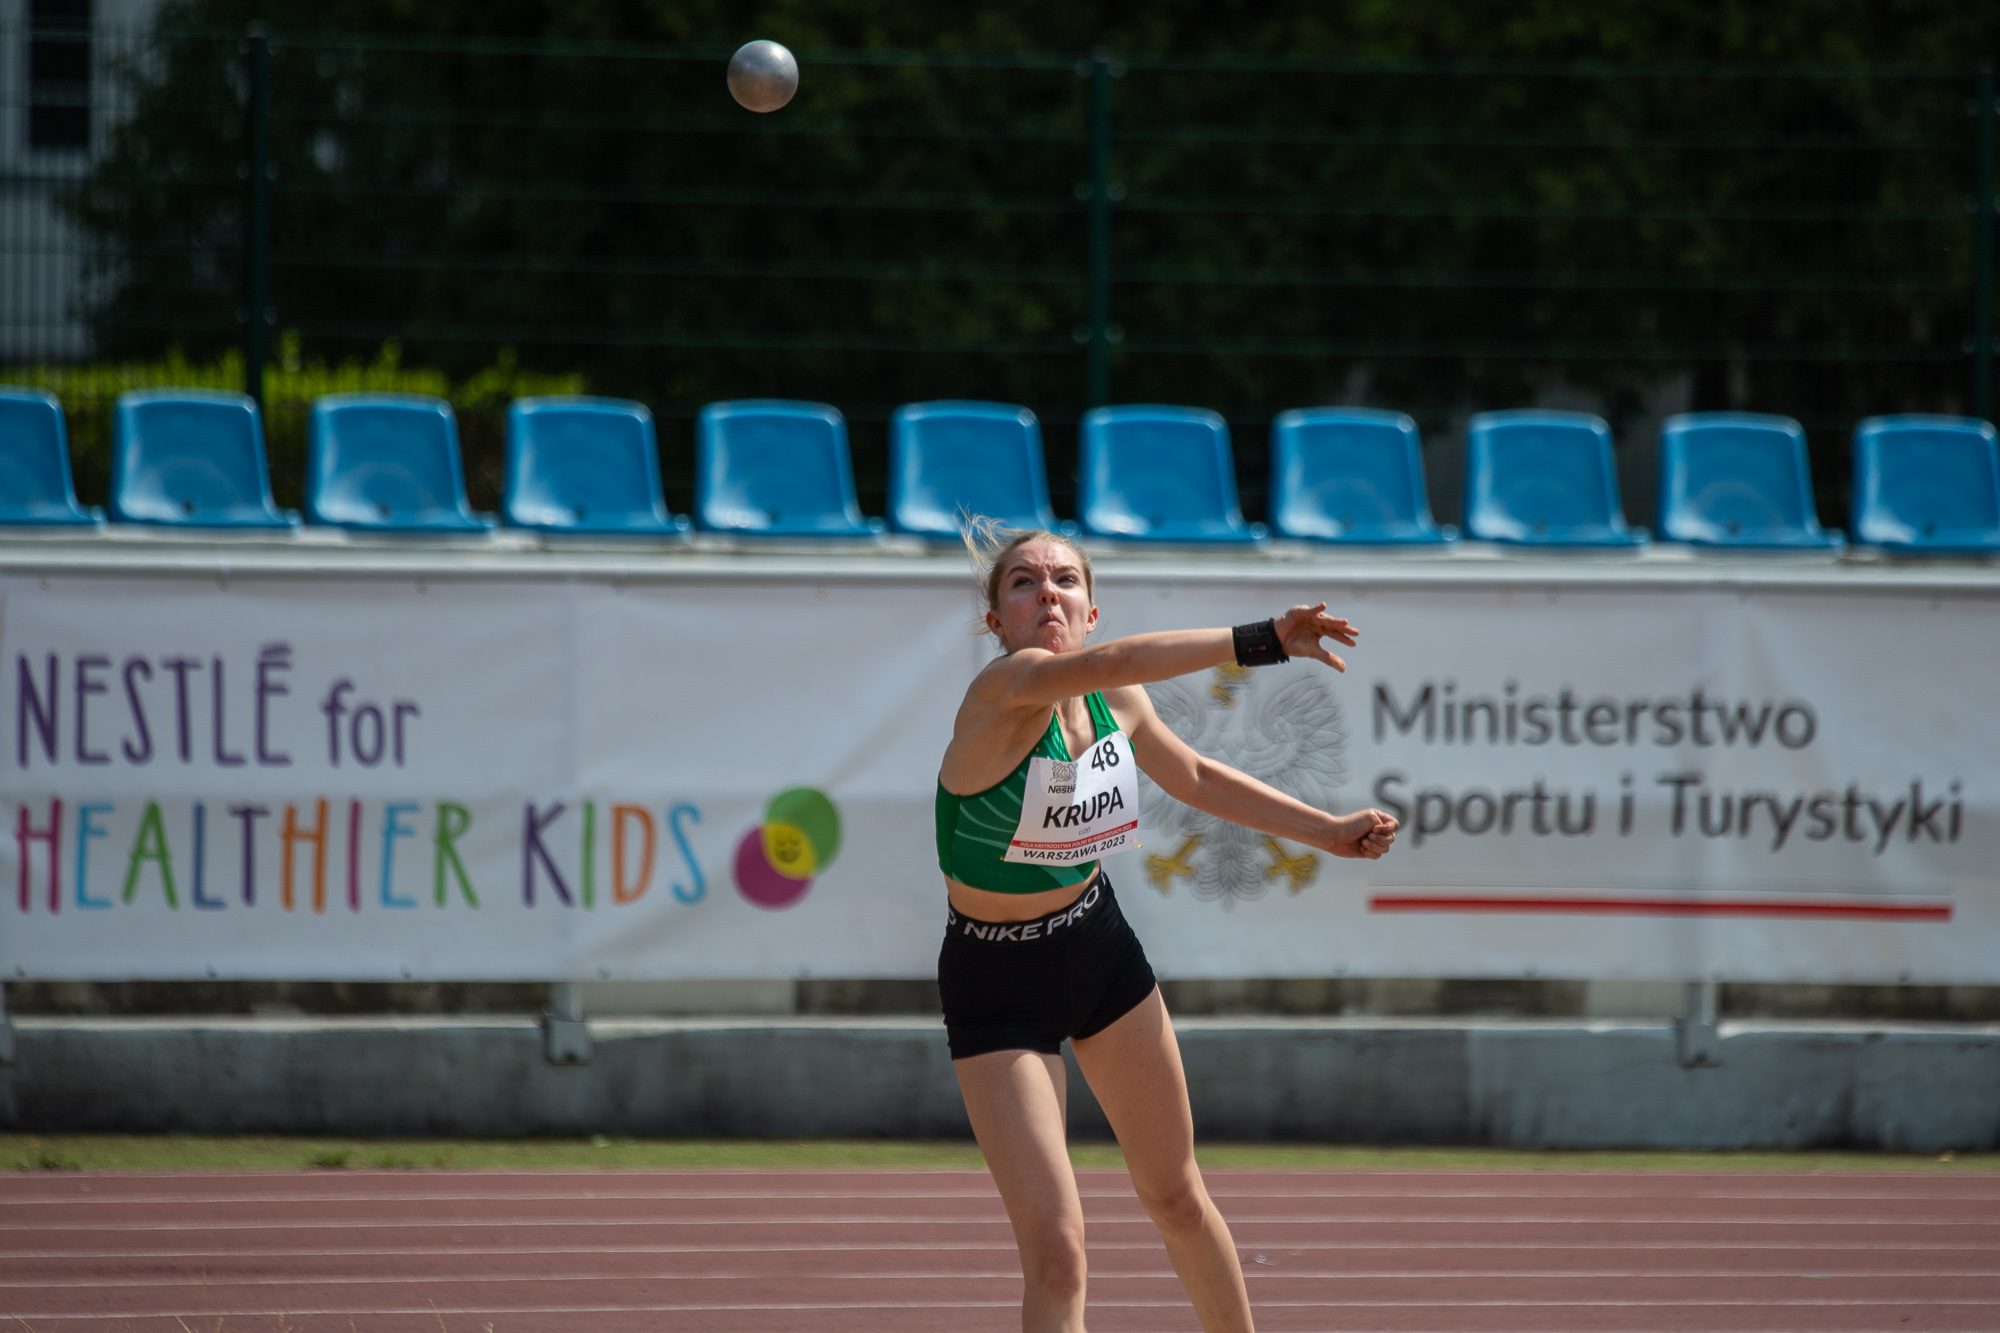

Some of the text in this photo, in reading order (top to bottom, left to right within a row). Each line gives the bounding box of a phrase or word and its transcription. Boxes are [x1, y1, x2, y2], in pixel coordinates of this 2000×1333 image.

[16, 642, 422, 769] NESTLÉ for
[1371, 678, 1818, 750] Ministerstwo
[1091, 740, 1120, 772] 48
[1042, 786, 1125, 828] KRUPA
[1372, 772, 1964, 855] Sportu i Turystyki
[14, 796, 706, 914] HEALTHIER KIDS
[1023, 834, 1126, 860] WARSZAWA 2023
[963, 885, 1099, 942] NIKE PRO
